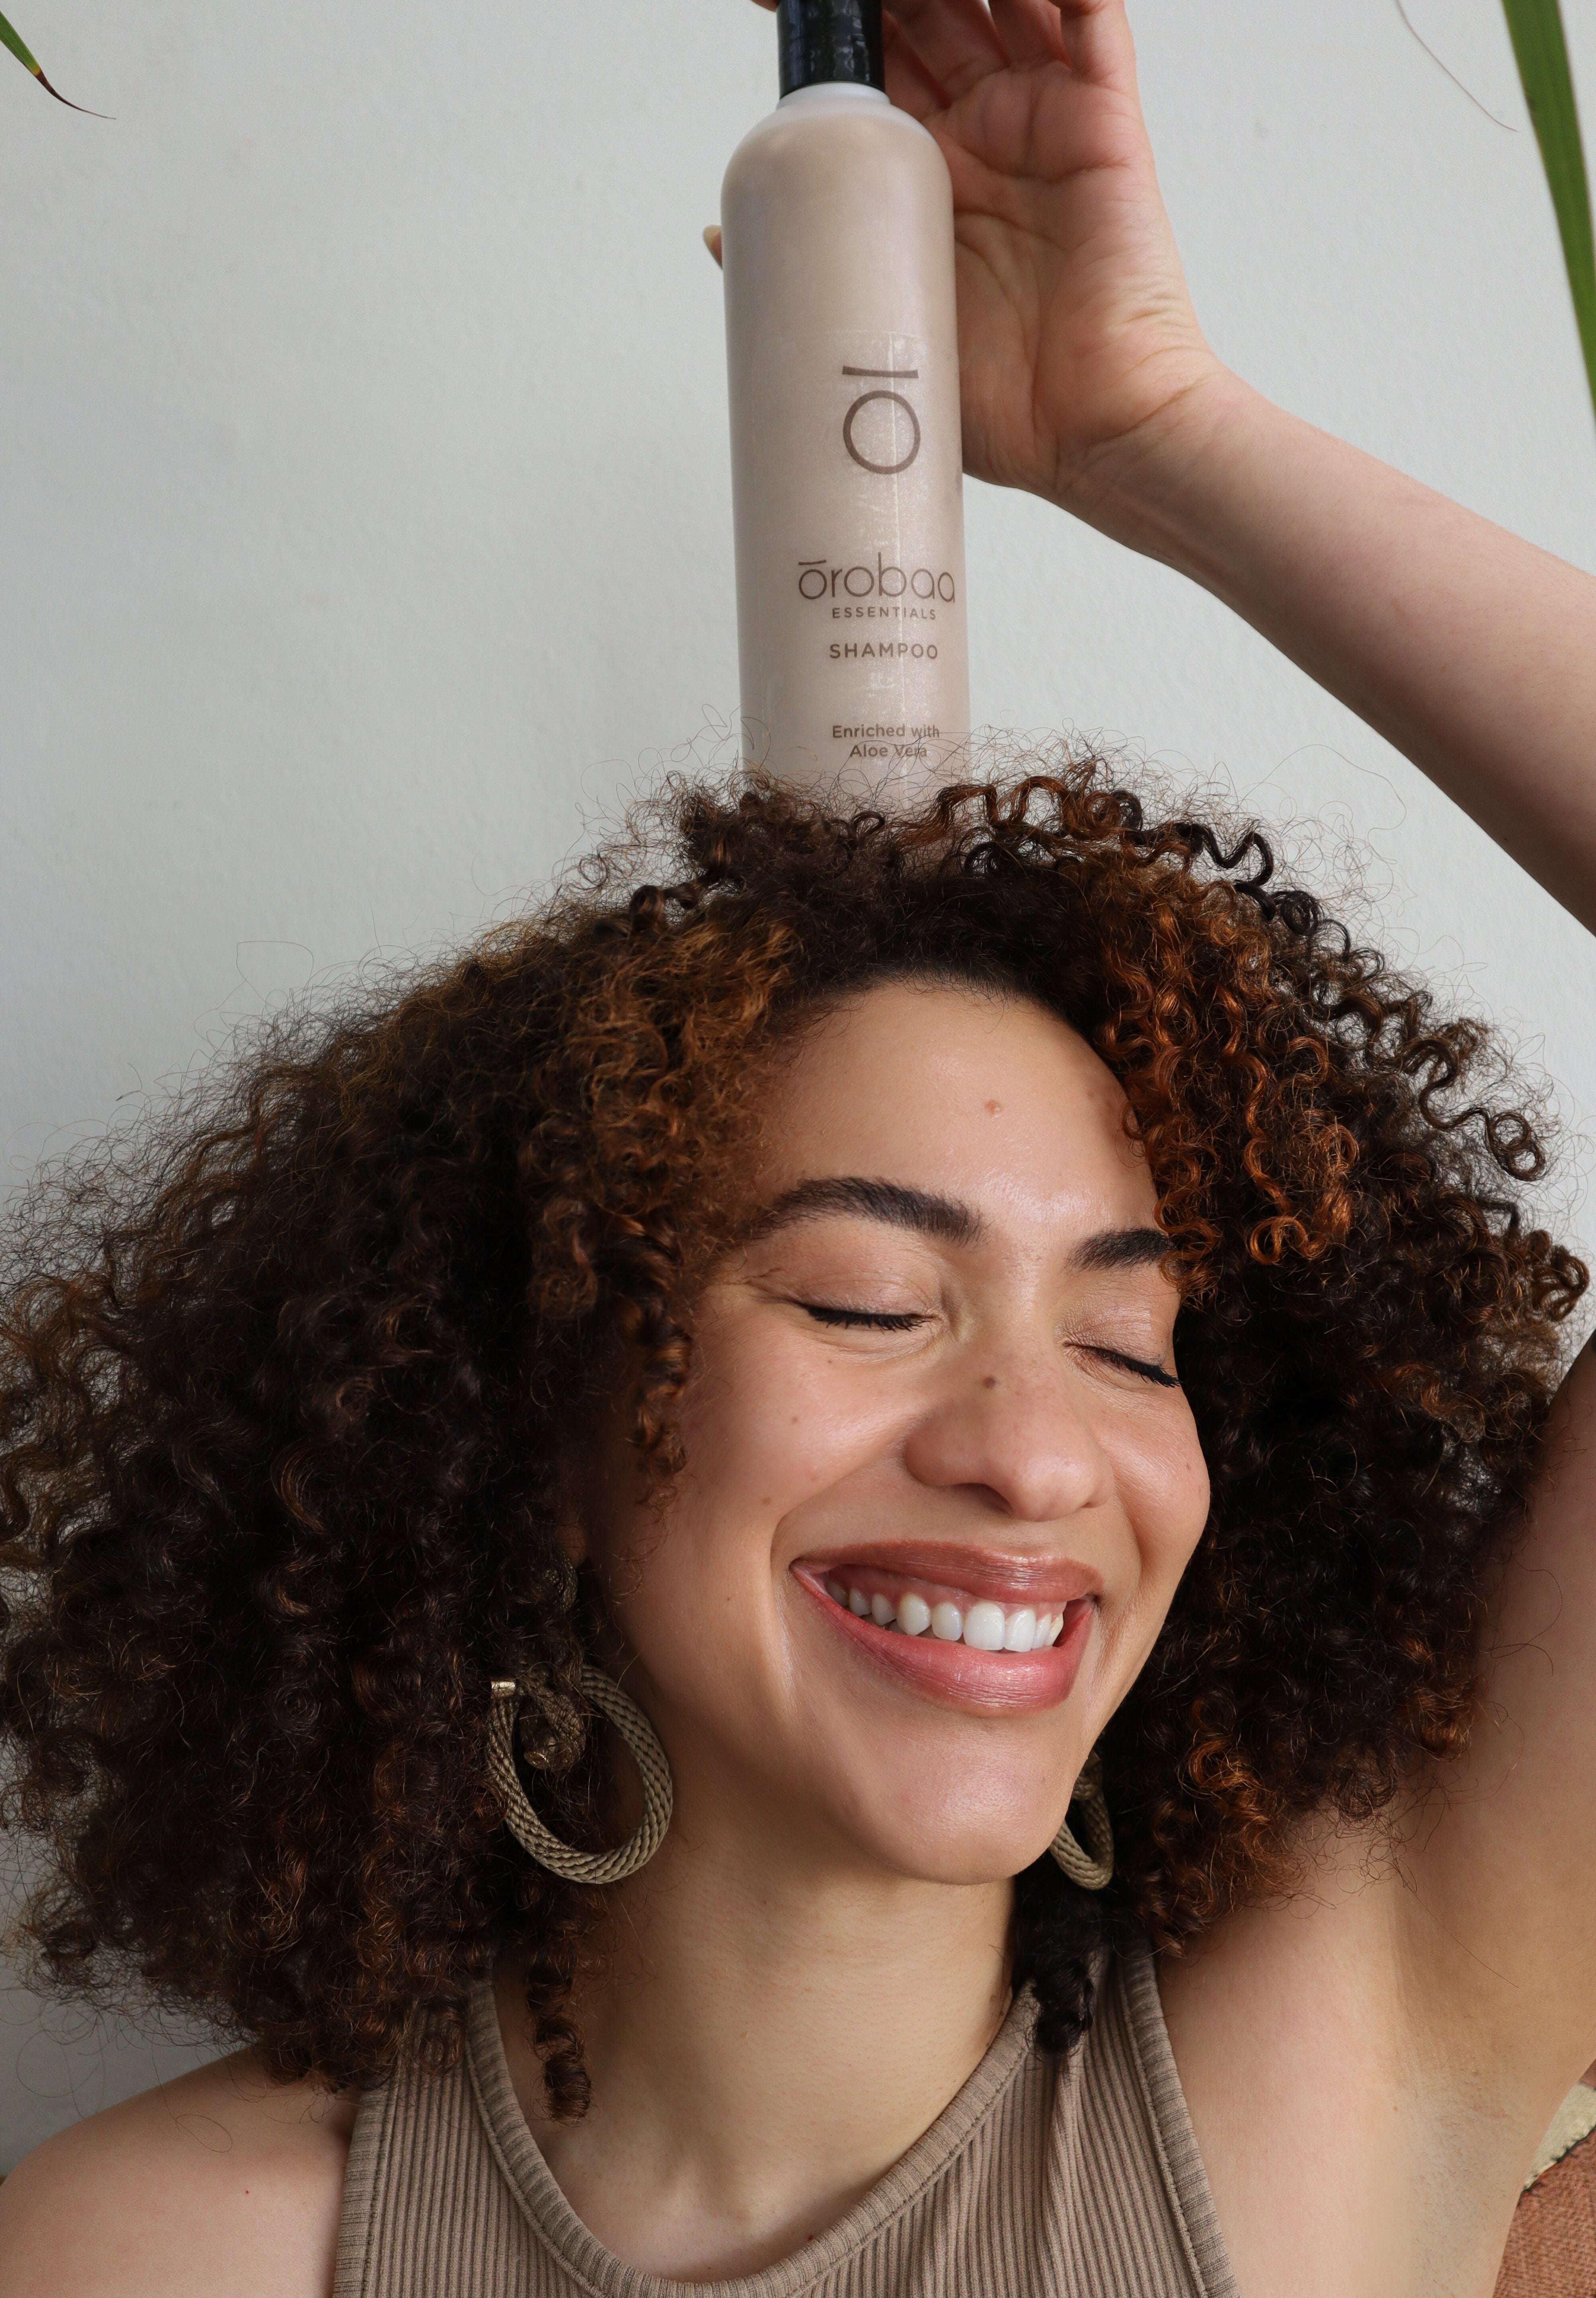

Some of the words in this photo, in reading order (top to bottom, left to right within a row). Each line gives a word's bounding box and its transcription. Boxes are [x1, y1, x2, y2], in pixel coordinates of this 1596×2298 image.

[832, 606, 936, 620] ESSENTIALS
[830, 642, 938, 659] SHAMPOO
[832, 724, 905, 738] Enriched
[911, 724, 940, 738] with
[849, 744, 888, 757] Aloe
[894, 744, 927, 757] Vera
